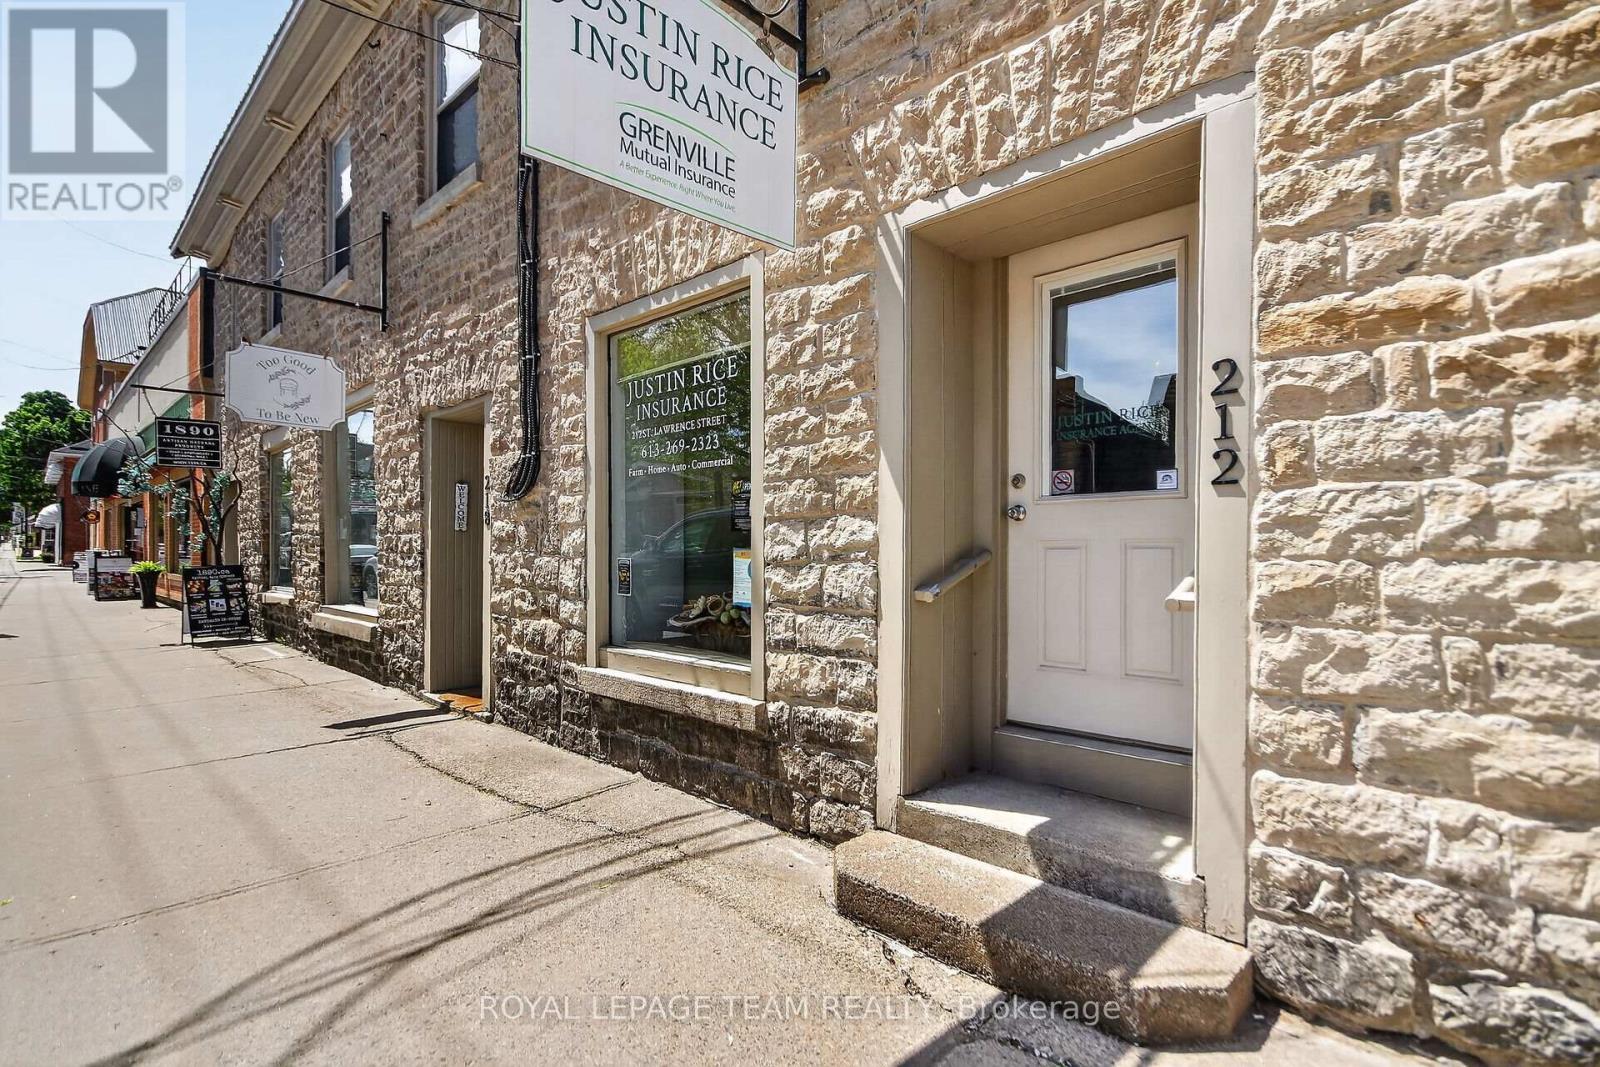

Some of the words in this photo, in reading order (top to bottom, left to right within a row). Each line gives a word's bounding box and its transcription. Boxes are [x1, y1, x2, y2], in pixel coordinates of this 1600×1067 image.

[552, 0, 700, 65] STIN
[711, 42, 783, 111] RICE
[571, 15, 776, 149] INSURANCE
[619, 112, 735, 181] GRENVILLE
[620, 137, 670, 171] Mutual
[675, 159, 736, 198] Insurance
[626, 162, 644, 176] Better
[679, 183, 695, 197] Right
[256, 357, 280, 370] Too
[284, 355, 317, 375] Good
[626, 369, 687, 407] JUSTIN
[692, 355, 740, 387] RICE
[256, 408, 272, 418] To
[276, 410, 291, 421] Be
[295, 412, 320, 424] New
[637, 386, 728, 421] INSURANCE
[1056, 411, 1113, 431] JUSTIN
[164, 424, 214, 436] 1890
[654, 420, 696, 436] LAWRENCE
[697, 415, 727, 429] STREET
[1056, 425, 1118, 441] INSURANCE
[1210, 358, 1239, 485] 212
[641, 434, 719, 458] 613-269-2323
[628, 468, 644, 477] Farm
[648, 465, 666, 475] Home
[671, 463, 687, 472] Auto
[691, 456, 734, 470] Commercial
[457, 485, 466, 528] WELCOME
